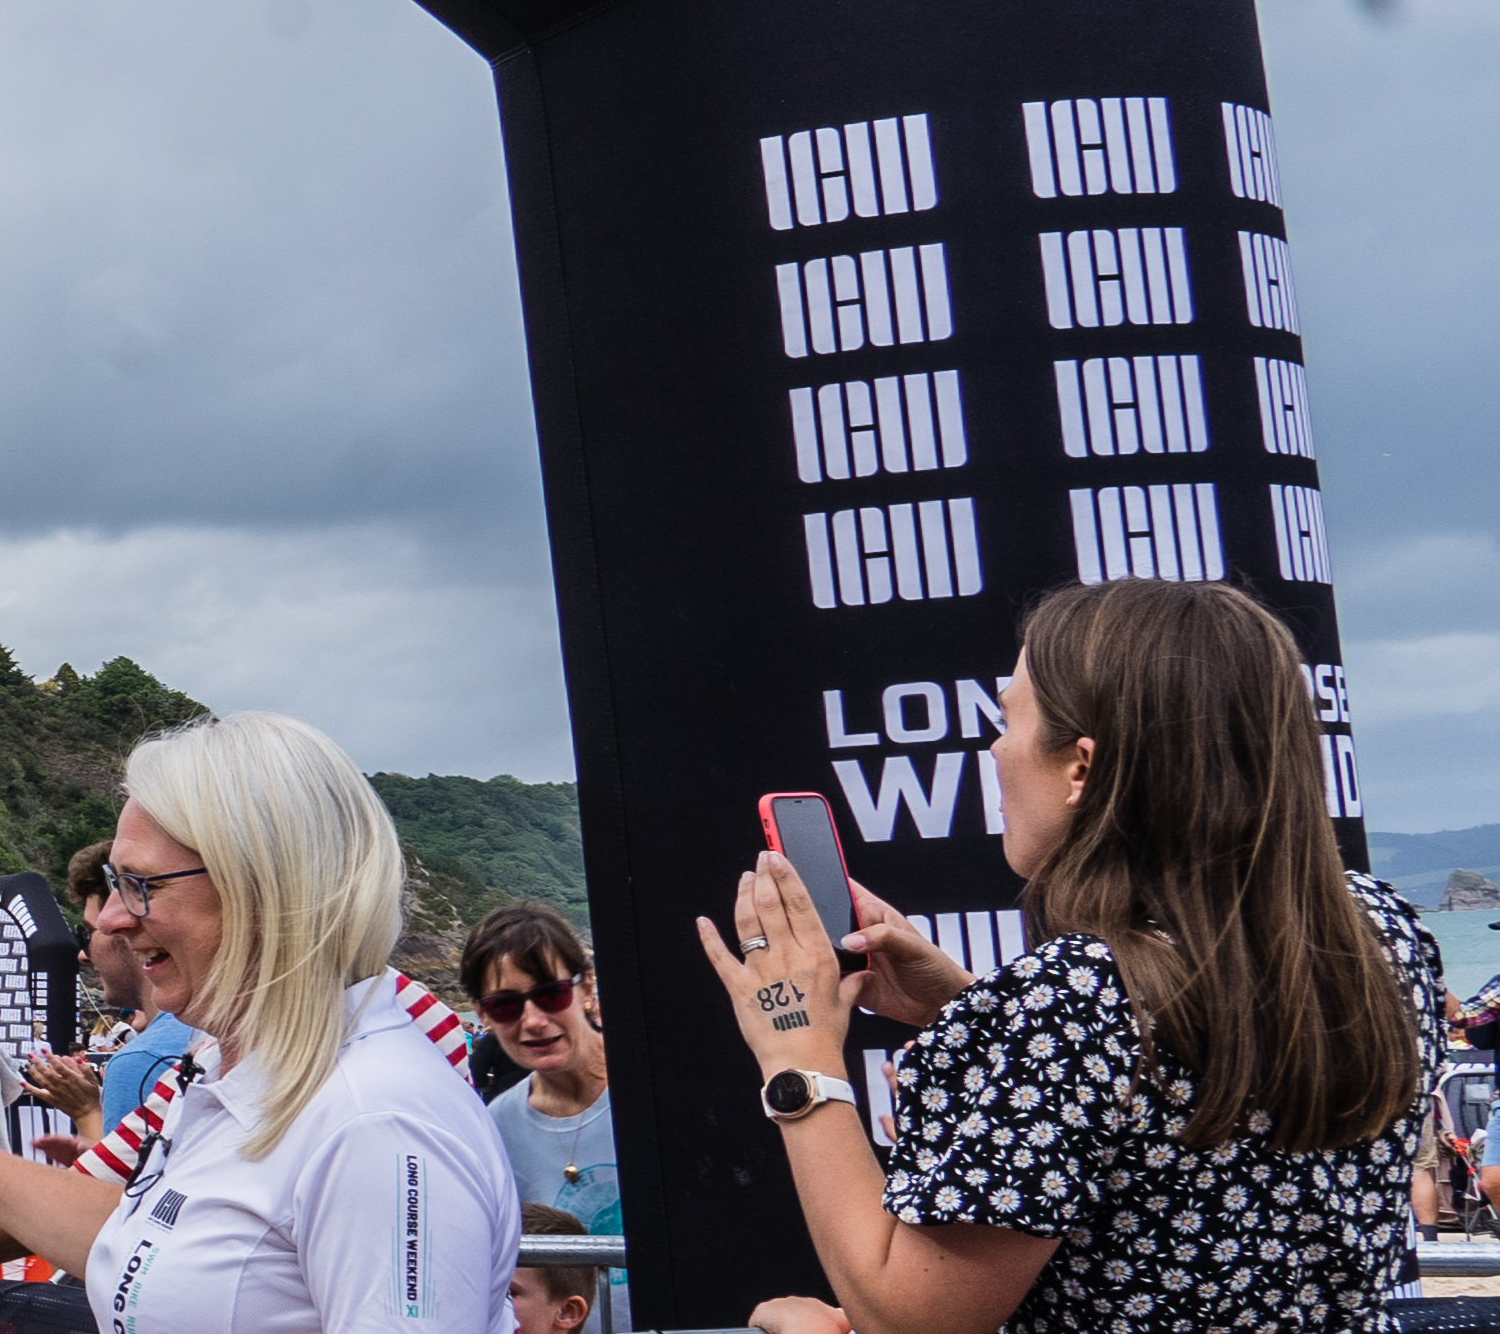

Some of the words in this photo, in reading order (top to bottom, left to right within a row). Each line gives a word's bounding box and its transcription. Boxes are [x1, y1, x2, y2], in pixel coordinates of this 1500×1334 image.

[823, 678, 1008, 750] LON
[406, 1155, 418, 1187] LONG
[406, 1189, 418, 1237] COURSE
[113, 1239, 153, 1313] LONG
[128, 1282, 142, 1309] BIKE
[406, 1239, 418, 1301] WEEKEND
